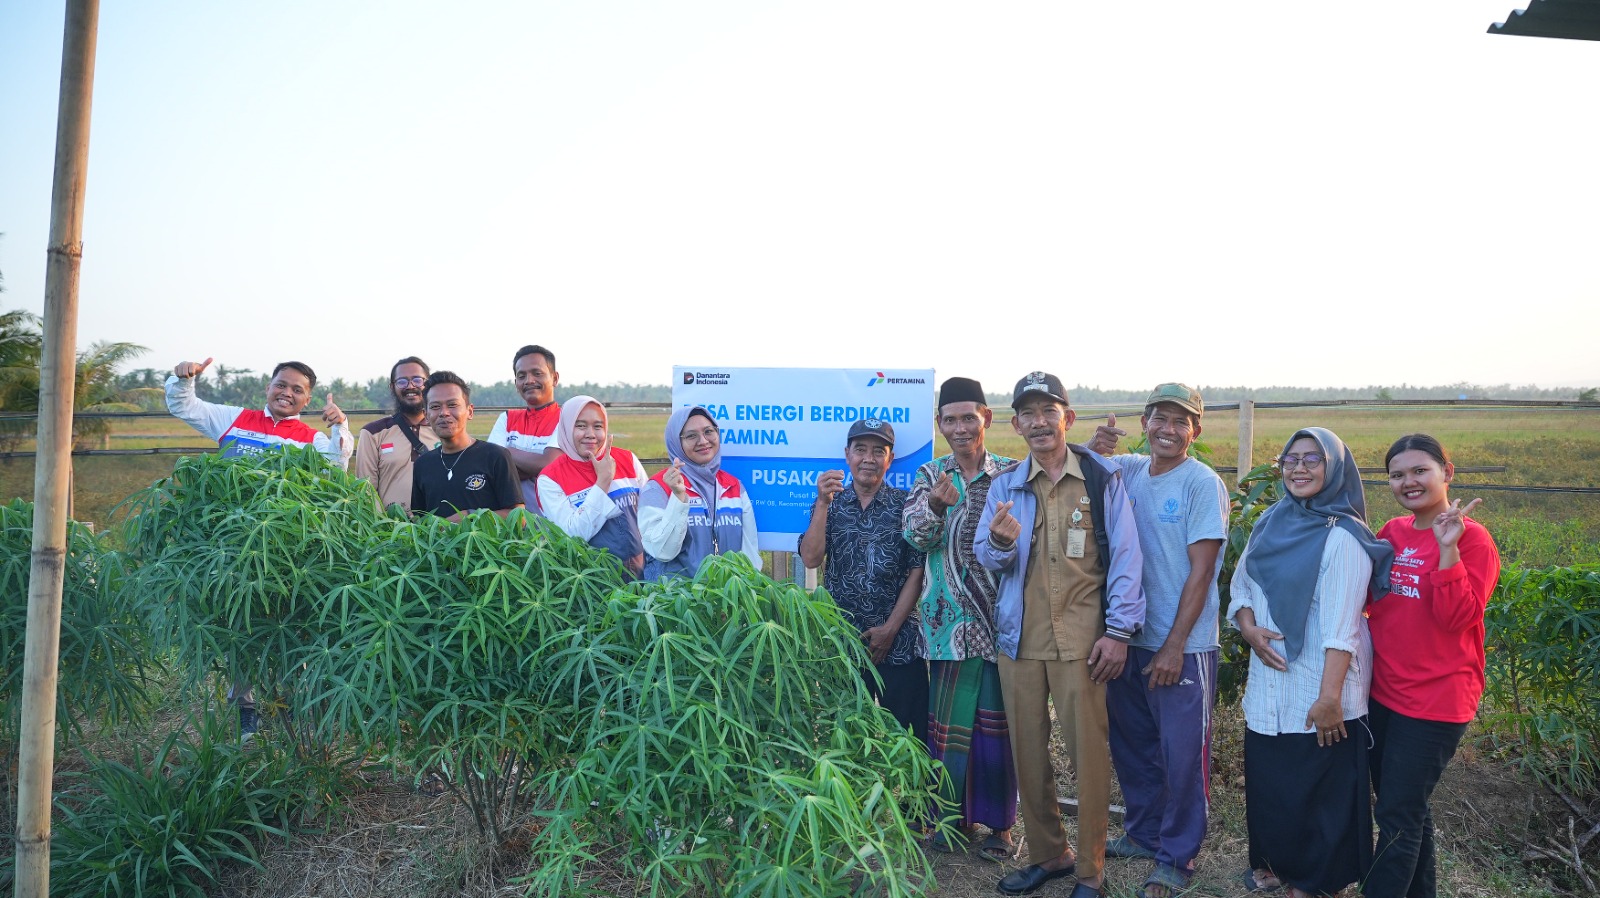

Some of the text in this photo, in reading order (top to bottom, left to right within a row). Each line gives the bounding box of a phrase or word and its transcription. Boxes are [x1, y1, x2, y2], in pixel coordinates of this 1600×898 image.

[736, 405, 803, 421] ENERGI
[811, 406, 909, 423] BERDIKARI
[719, 429, 788, 445] TAMINA
[1390, 583, 1420, 600] NESIA
